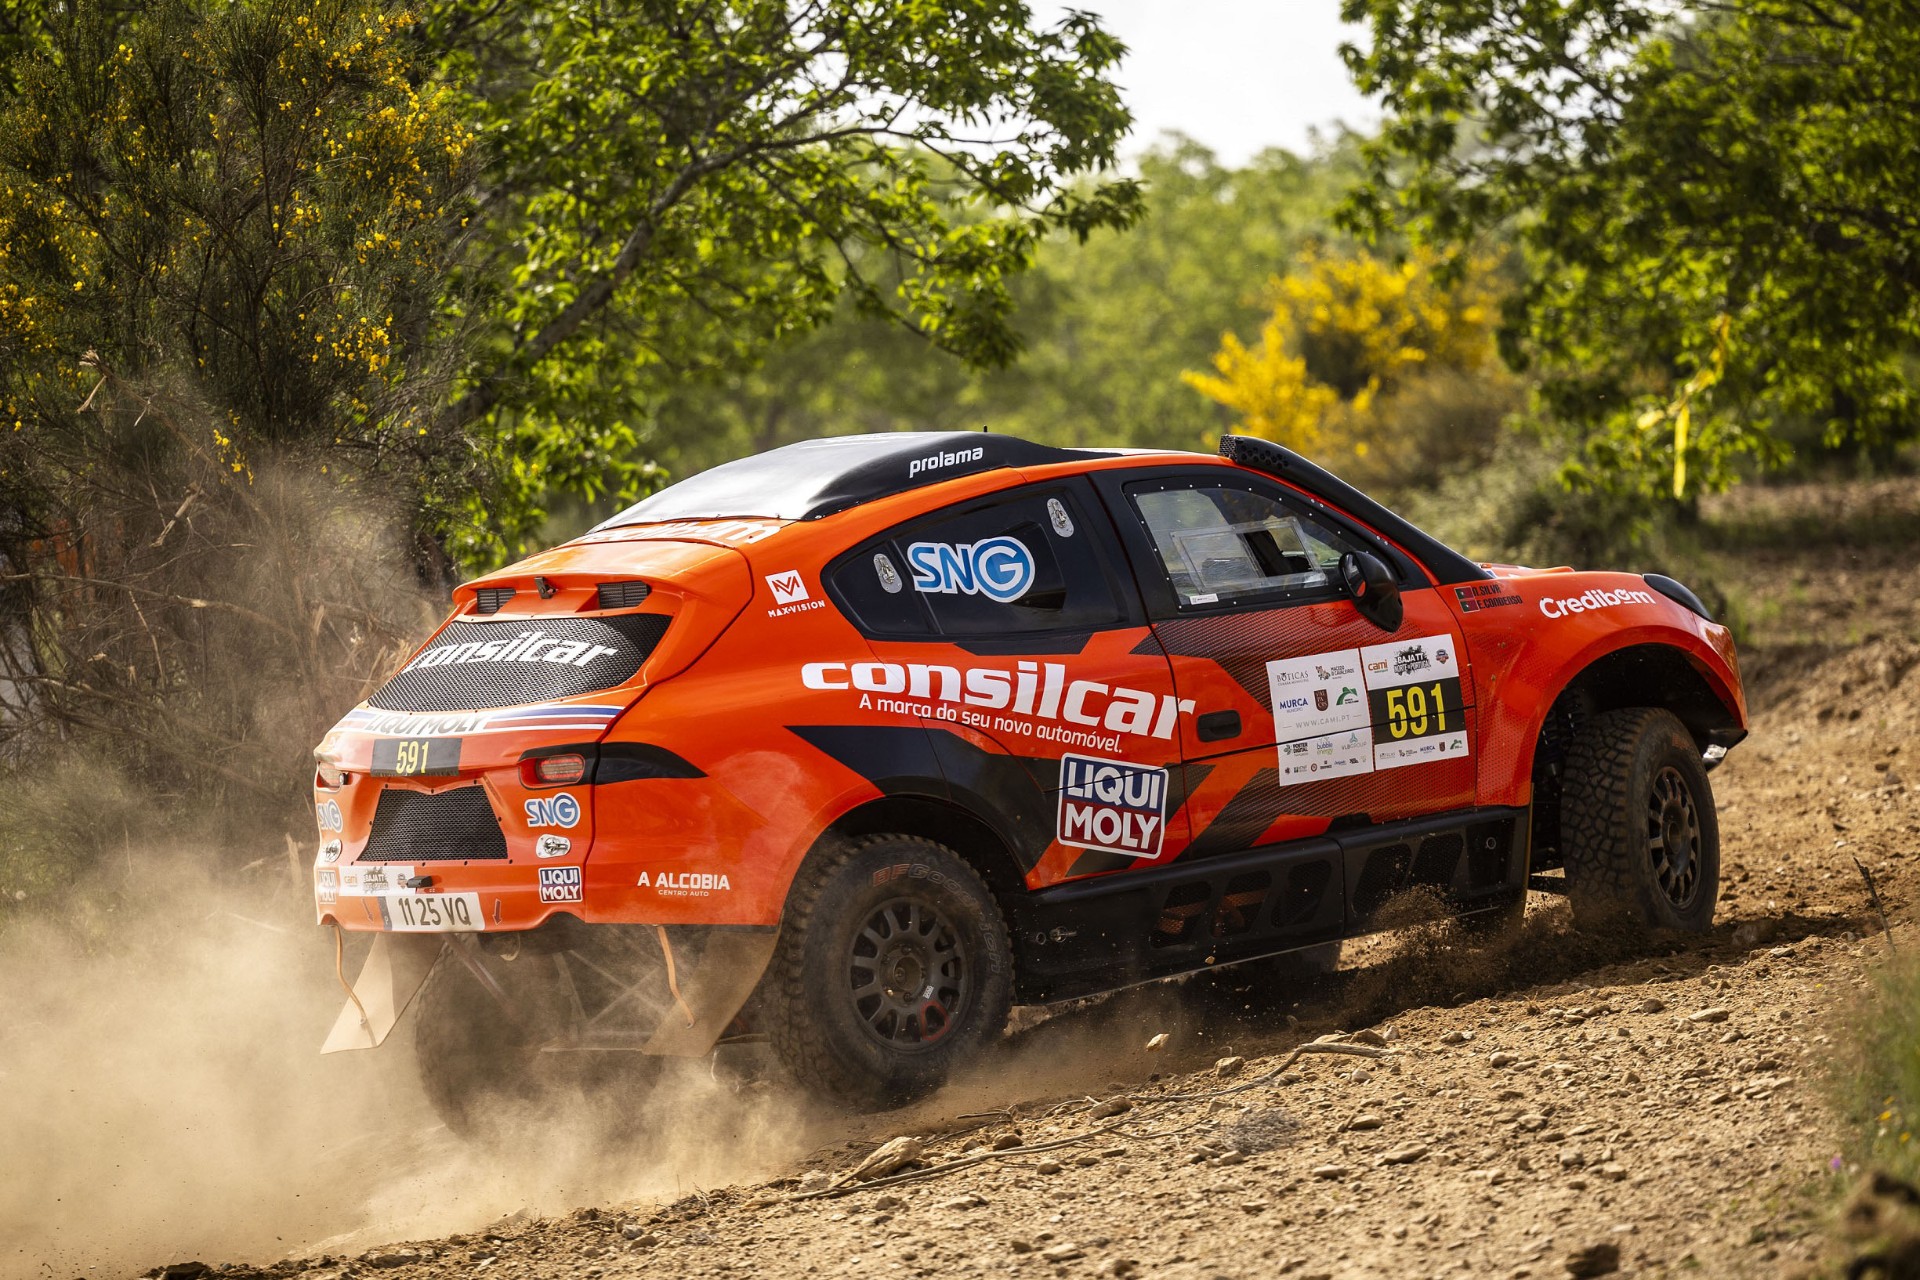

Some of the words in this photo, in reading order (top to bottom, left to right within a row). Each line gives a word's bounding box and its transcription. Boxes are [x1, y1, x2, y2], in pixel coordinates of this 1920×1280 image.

[909, 447, 984, 478] prolama
[909, 537, 1034, 601] SNG
[1539, 588, 1656, 618] Credibom
[1277, 670, 1309, 682] BOTICAS
[1368, 658, 1388, 671] cami
[801, 660, 1197, 740] consilcar
[1387, 683, 1446, 739] 591
[365, 713, 419, 734] LIQUI
[416, 715, 487, 736] MOLY
[859, 693, 873, 711] A
[877, 695, 931, 718] marca
[936, 703, 957, 722] do
[961, 710, 990, 729] seu
[994, 717, 1032, 737] novo
[1036, 724, 1123, 754] automóvel.
[1296, 714, 1350, 728] WWW.CAMI.PT
[395, 741, 430, 774] 591
[1317, 741, 1333, 750] bubble
[1067, 761, 1161, 809] LIQUI
[525, 793, 580, 828] SNG
[1064, 802, 1161, 850] MOLY
[541, 870, 579, 886] LIQUI
[637, 871, 651, 887] A
[655, 872, 730, 890] ALCOBIA
[541, 886, 580, 901] MOLY
[415, 897, 441, 926] 25
[441, 897, 472, 926] VQ
